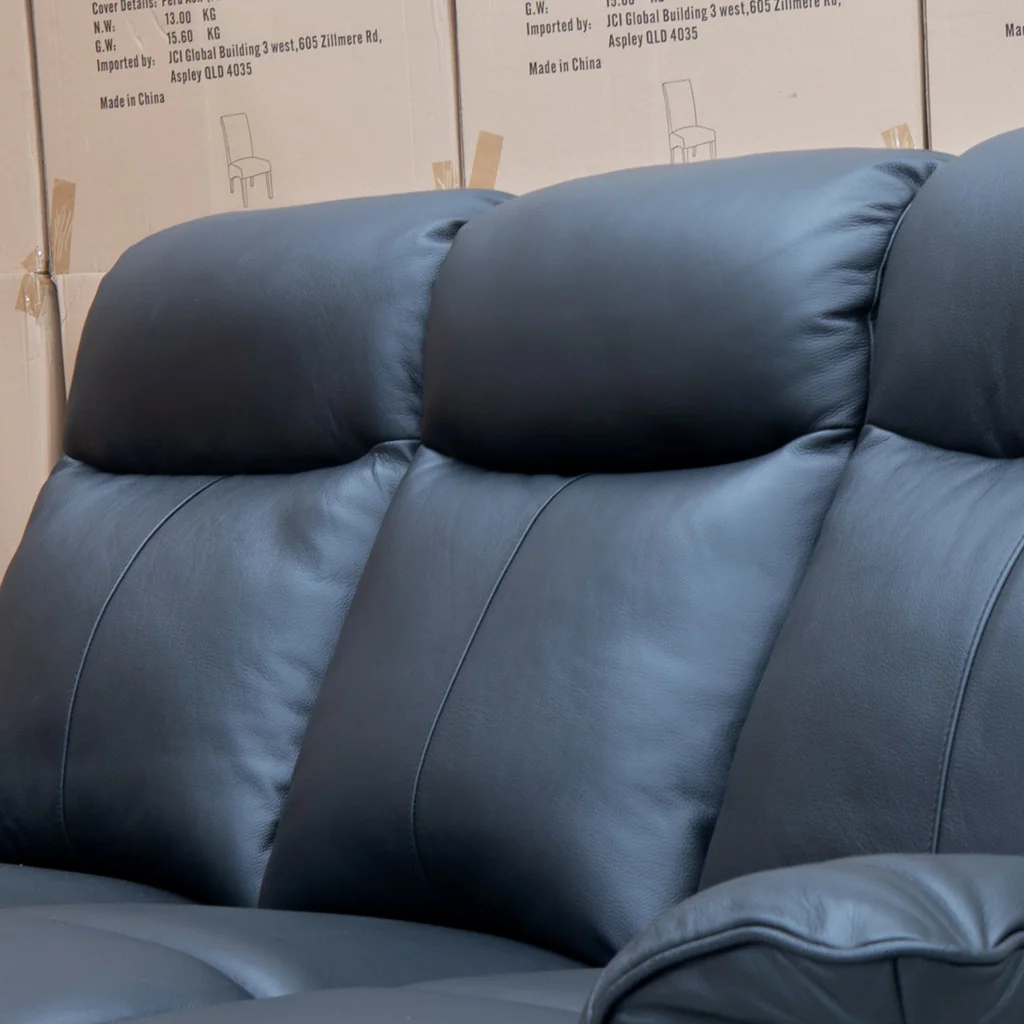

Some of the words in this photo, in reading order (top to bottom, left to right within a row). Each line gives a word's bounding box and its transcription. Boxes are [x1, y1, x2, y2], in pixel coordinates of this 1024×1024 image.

[92, 2, 118, 15] Cover
[120, 0, 157, 11] Details:
[525, 1, 549, 16] G.W:
[526, 17, 574, 37] Imported
[576, 16, 592, 33] by:
[606, 11, 623, 29] JCI
[625, 8, 660, 26] Global
[662, 4, 708, 22] Building
[709, 3, 717, 18] 3
[93, 20, 116, 35] N.W:
[164, 10, 192, 26] 13.00
[202, 7, 217, 21] KG
[95, 38, 117, 53] G.W:
[166, 29, 194, 45] 15.60
[206, 26, 221, 41] KG
[608, 32, 643, 49] Aspley
[646, 27, 668, 45] QLD
[670, 24, 699, 41] 4035
[96, 54, 140, 73] Imported
[141, 53, 156, 69] by:
[168, 48, 184, 64] JCI
[185, 44, 217, 62] Global
[218, 41, 261, 58] Building
[262, 40, 270, 55] 3
[320, 32, 365, 49] Zillmere
[365, 28, 383, 45] Rd,
[170, 65, 202, 85] Aspley
[204, 62, 225, 81] QLD
[226, 60, 253, 79] 4035
[528, 60, 557, 76] Made
[559, 58, 570, 73] in
[571, 55, 603, 72] China
[100, 94, 125, 110] Made
[127, 92, 137, 107] in
[138, 91, 165, 106] China
